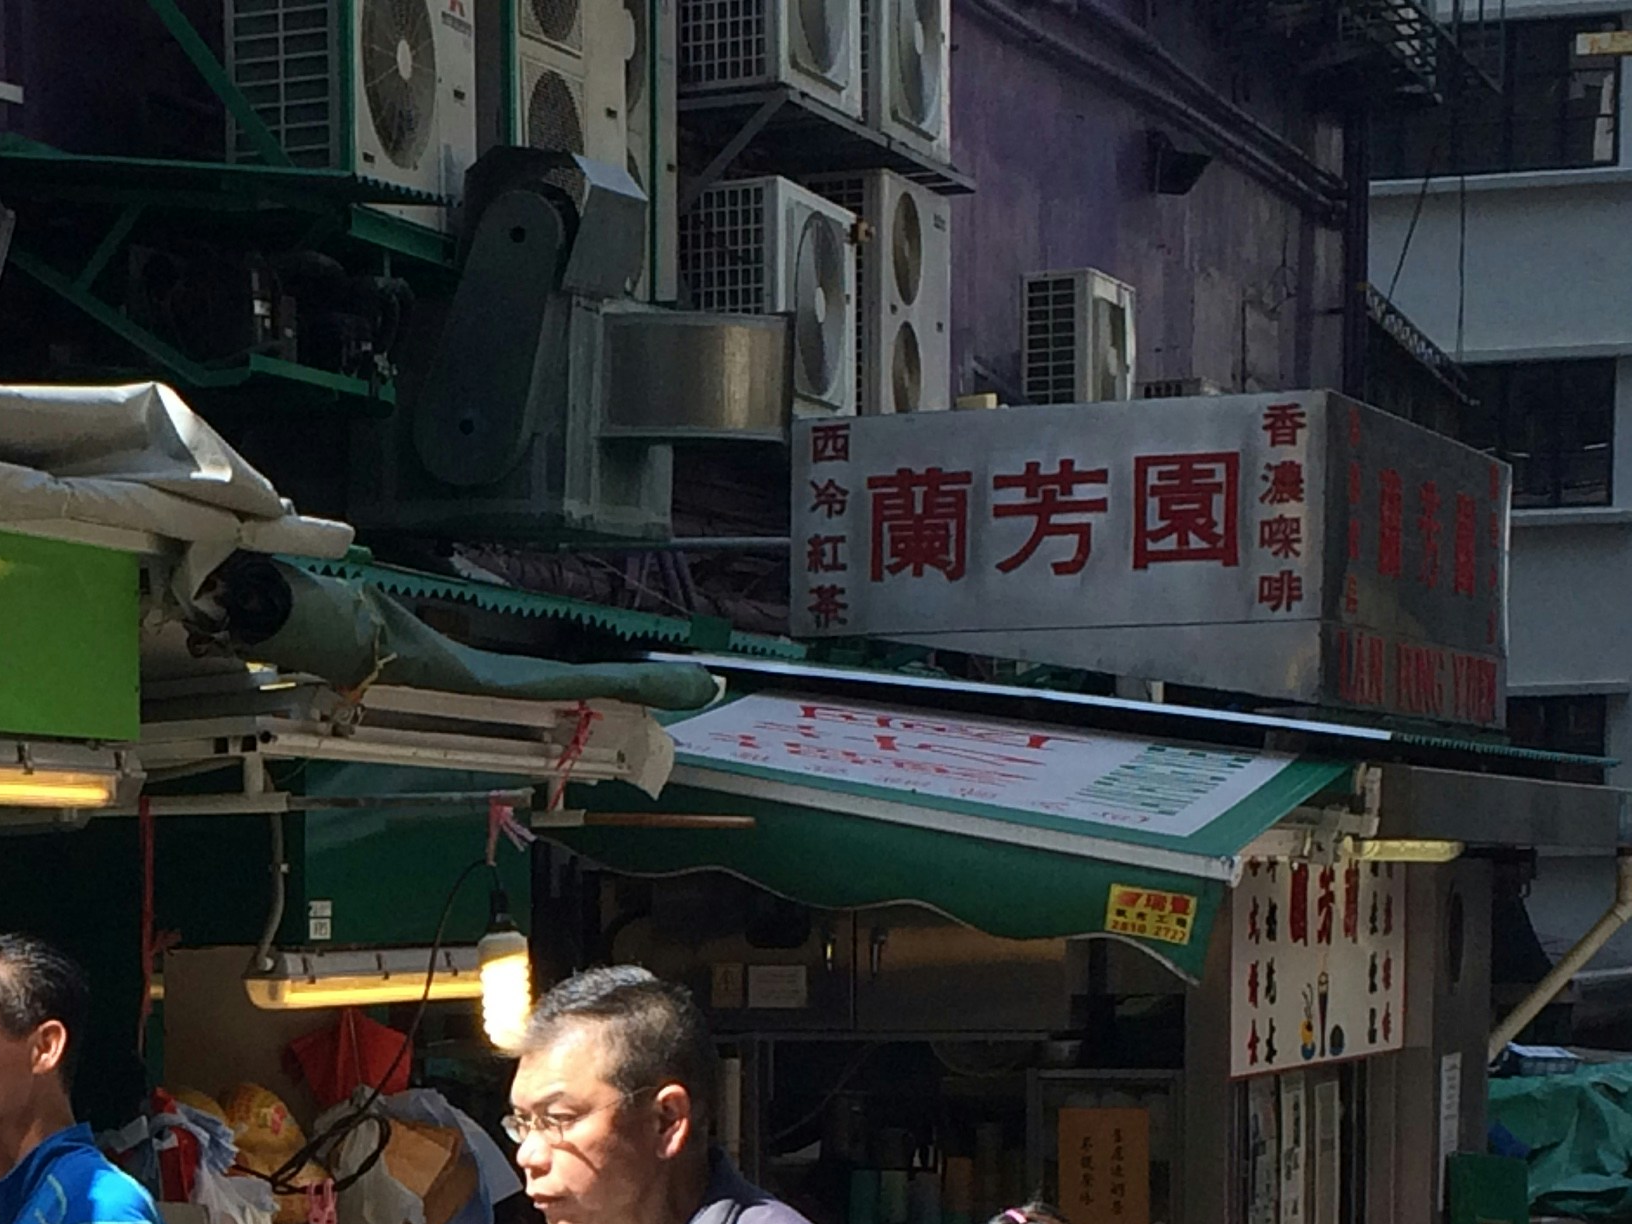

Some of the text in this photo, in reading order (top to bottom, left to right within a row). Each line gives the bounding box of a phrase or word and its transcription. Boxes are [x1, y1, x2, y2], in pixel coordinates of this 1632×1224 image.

[807, 424, 851, 629] 西冷紅茶
[867, 452, 1240, 583] 蘭芳園
